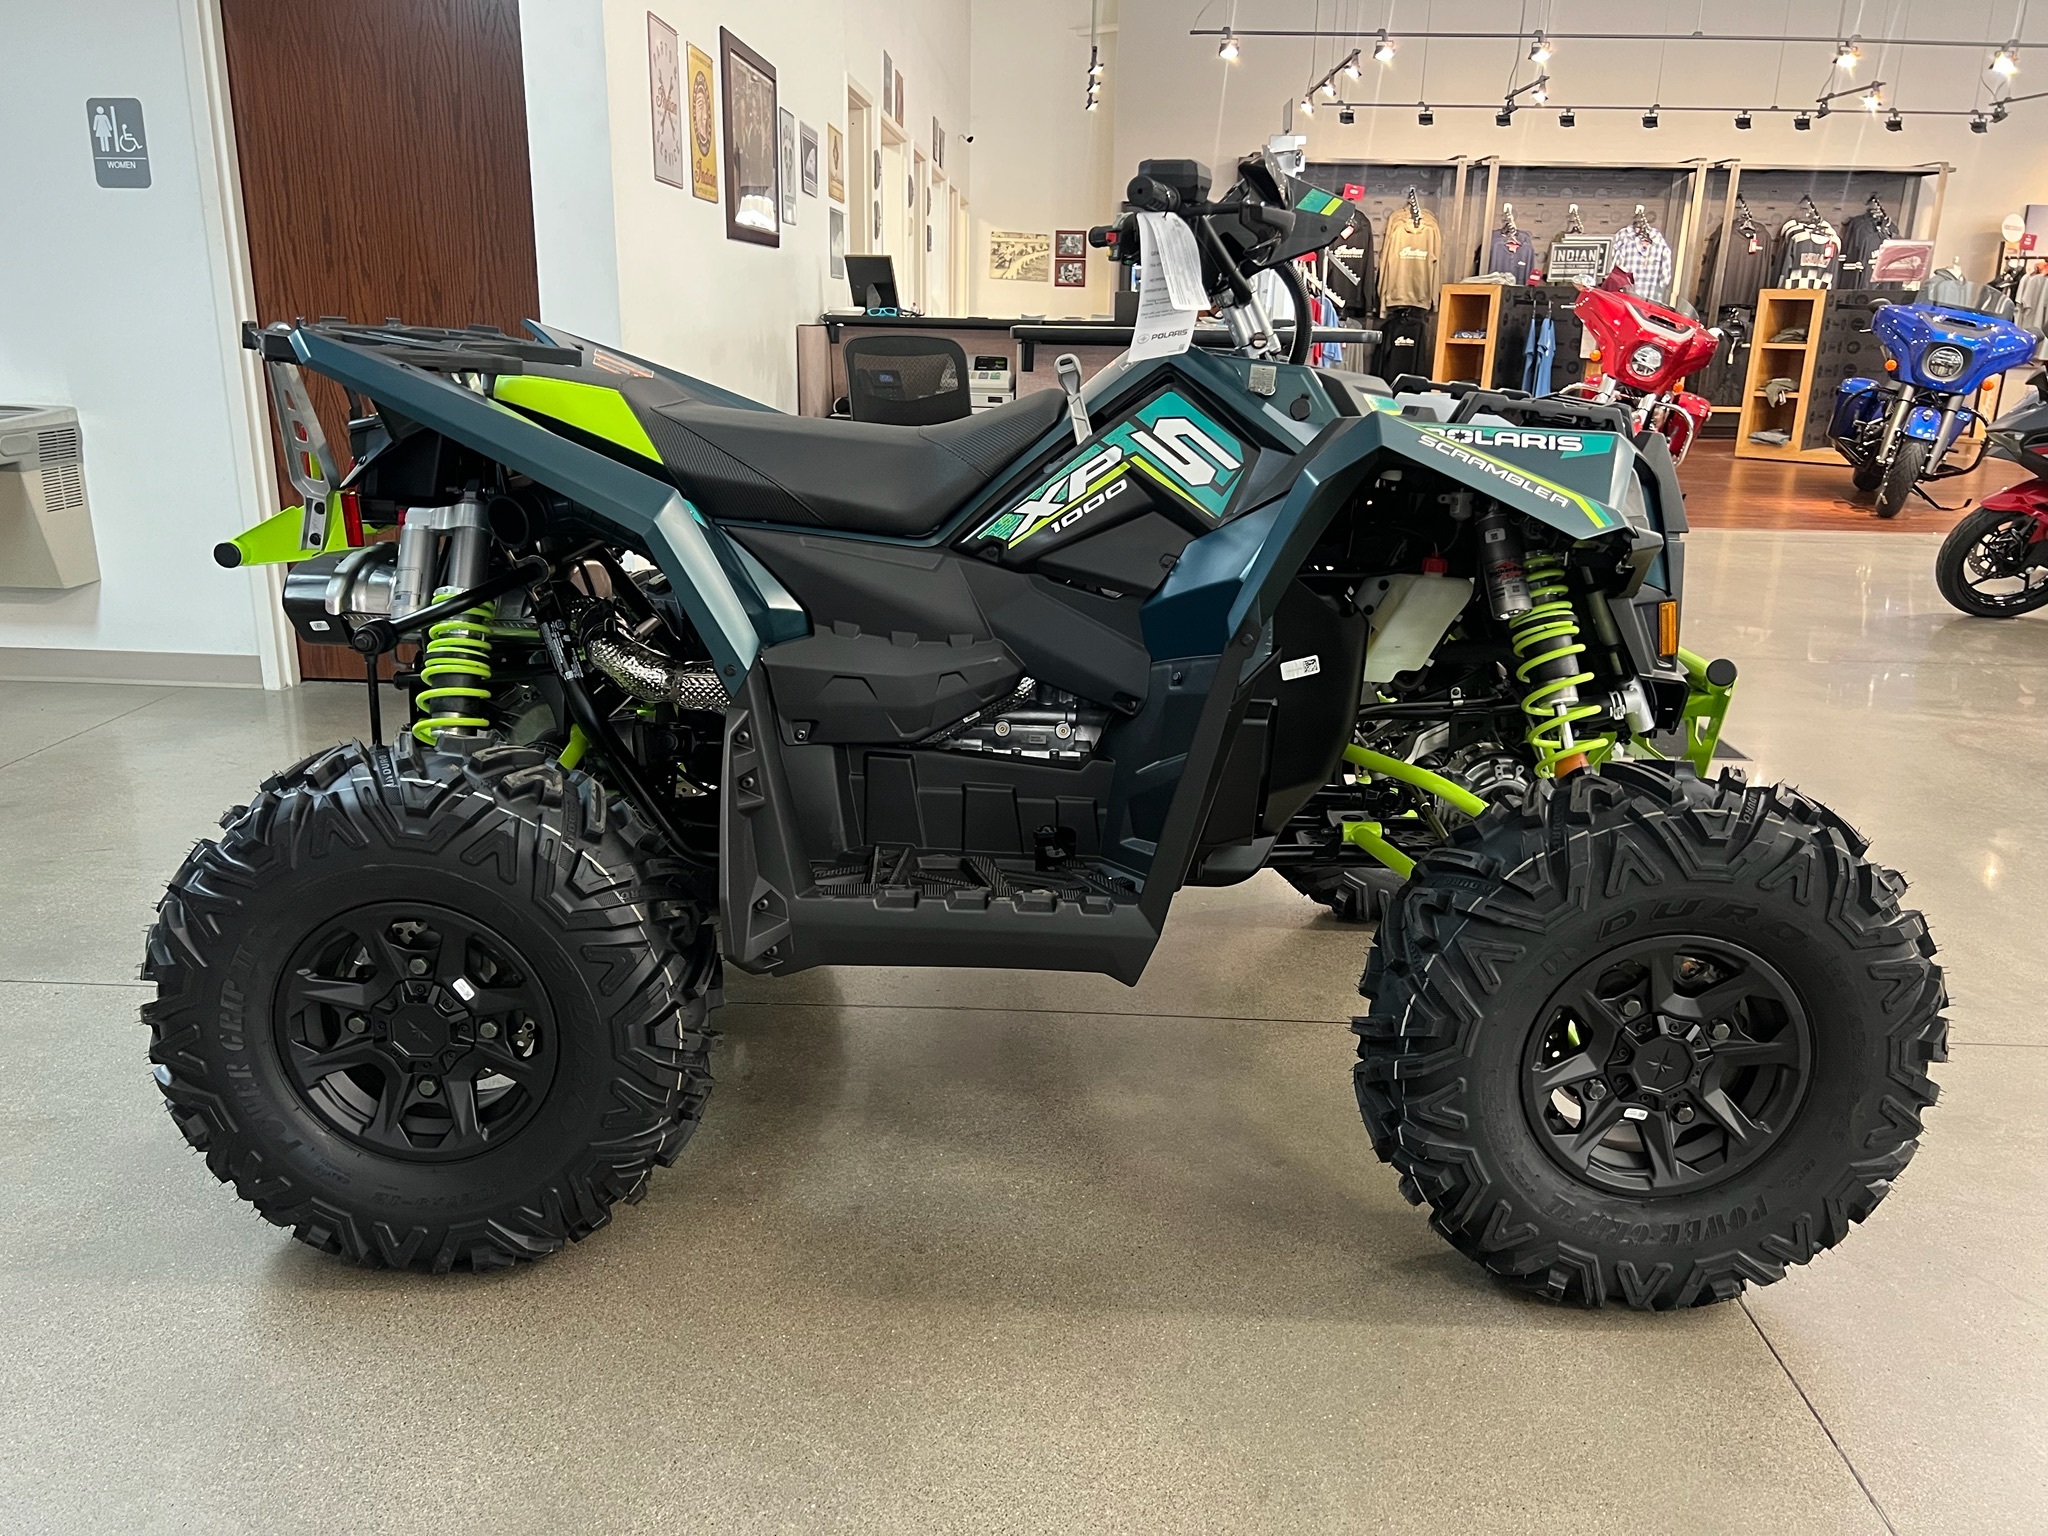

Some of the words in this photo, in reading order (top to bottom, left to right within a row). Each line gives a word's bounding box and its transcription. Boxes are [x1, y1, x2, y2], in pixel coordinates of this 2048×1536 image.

[106, 161, 136, 169] WOMEN
[694, 158, 717, 188] Indian
[1553, 249, 1597, 262] INDIAN
[1151, 328, 1189, 341] POLARIS
[1008, 444, 1124, 542] XP
[1417, 433, 1571, 508] SCRAMBLER
[1050, 478, 1128, 533] 1000
[1743, 796, 1757, 823] DURO
[1596, 898, 1808, 946] DURO
[218, 977, 246, 1051] GRIP
[226, 1062, 304, 1150] POWER
[1573, 1210, 1651, 1246] GRIP
[1659, 1192, 1769, 1246] POWER
